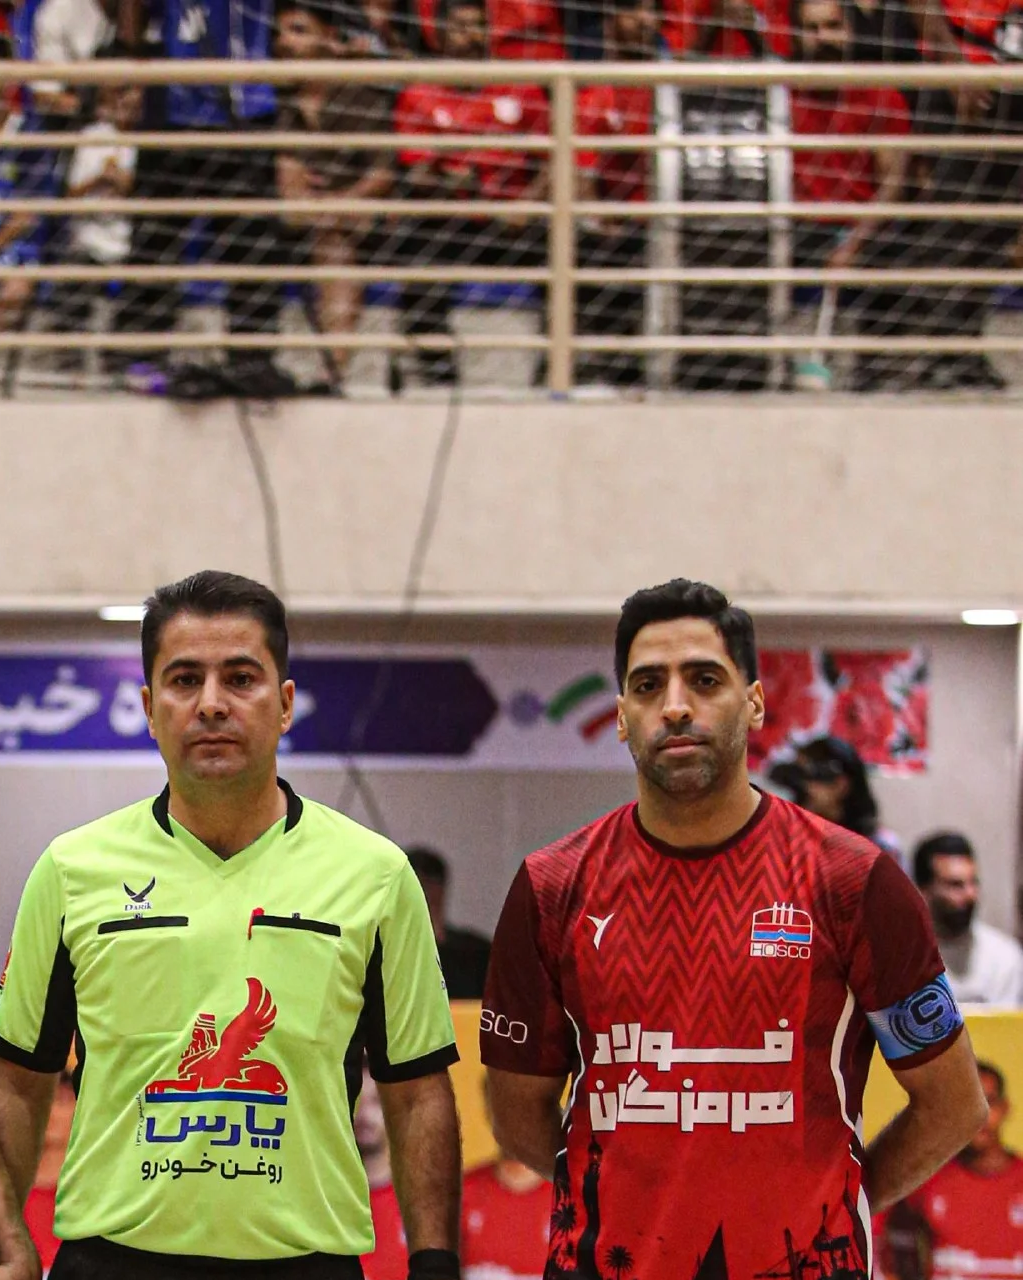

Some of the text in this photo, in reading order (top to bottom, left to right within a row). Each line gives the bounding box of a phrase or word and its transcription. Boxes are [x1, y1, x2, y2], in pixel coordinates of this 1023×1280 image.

[750, 943, 811, 959] HOSCO
[480, 1008, 528, 1044] SCO
[909, 990, 944, 1026] C
[592, 1018, 794, 1072] فولاد
[589, 1068, 794, 1133] هرمزگان
[145, 1105, 286, 1150] پارس
[141, 1152, 282, 1184] روغن خودرو
